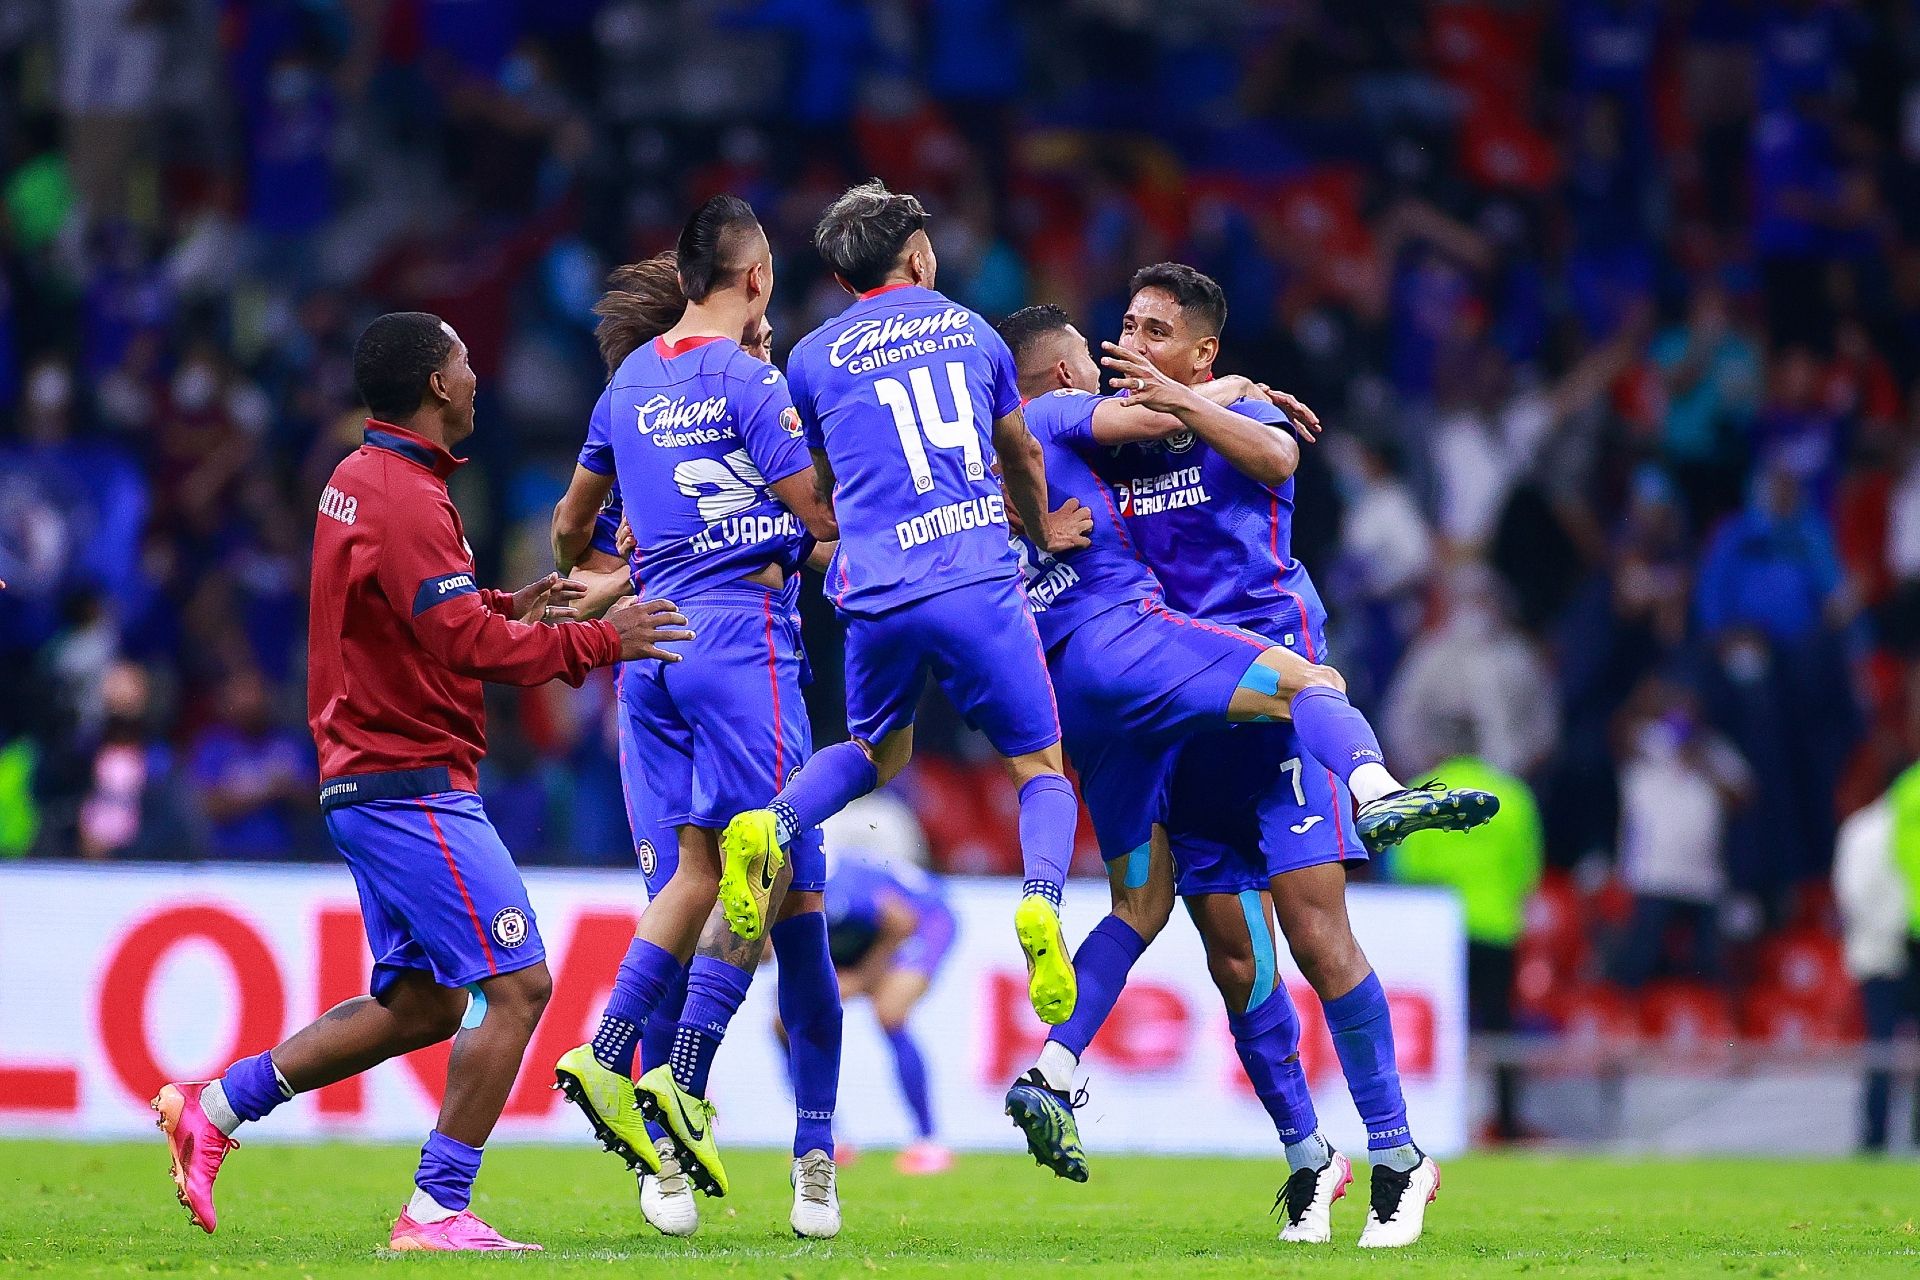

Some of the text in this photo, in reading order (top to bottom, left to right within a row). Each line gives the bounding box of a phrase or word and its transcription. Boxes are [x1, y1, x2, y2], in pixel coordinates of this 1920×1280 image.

[826, 308, 970, 367] Caliente
[848, 333, 977, 374] caliente.mx
[873, 361, 985, 496] 14
[319, 484, 358, 526] oma
[1167, 485, 1212, 510] AZUL
[896, 494, 1009, 551] DOMINGUE
[437, 575, 473, 594] Jom
[1279, 757, 1306, 806] 7
